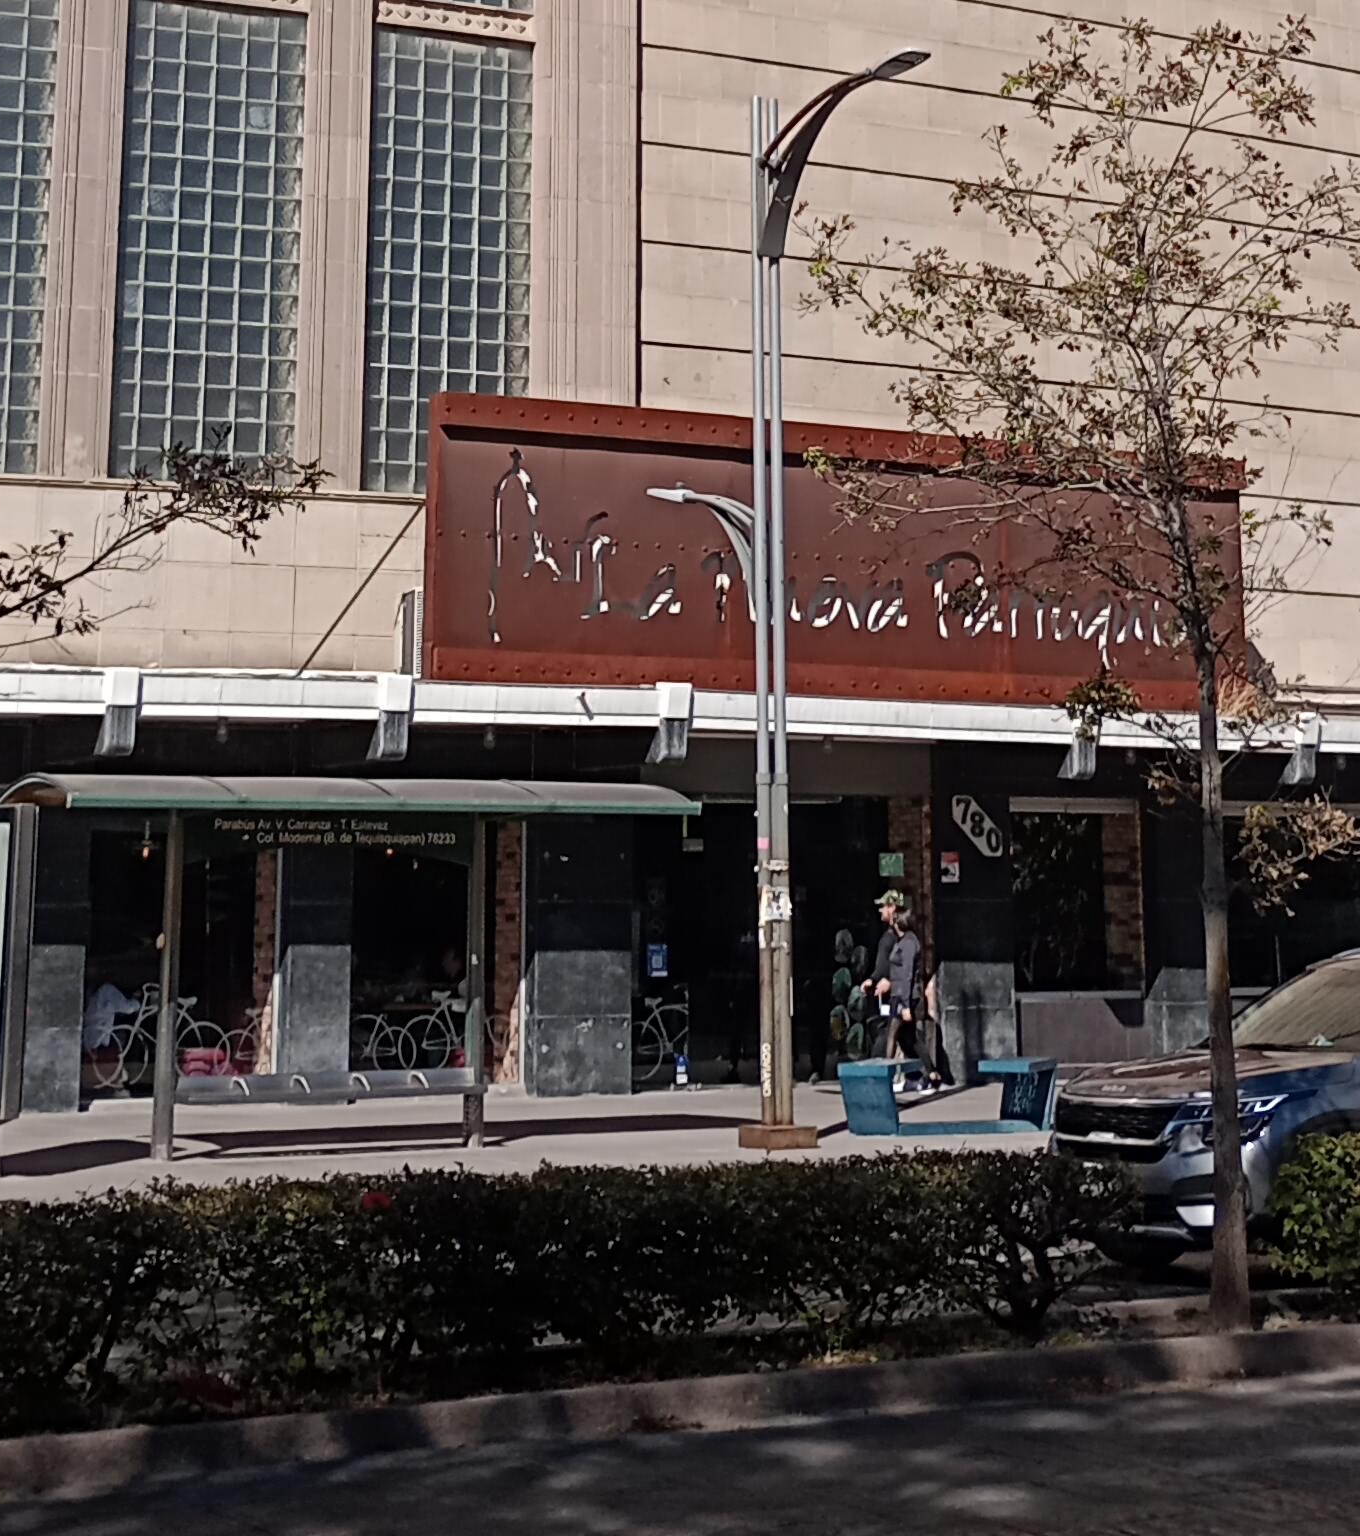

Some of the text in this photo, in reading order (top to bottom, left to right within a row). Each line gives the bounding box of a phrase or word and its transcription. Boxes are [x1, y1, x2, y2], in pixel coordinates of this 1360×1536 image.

[578, 511, 683, 621] La
[287, 818, 332, 830] Carranza
[339, 832, 353, 844] de
[427, 832, 457, 845] 78233
[955, 796, 1001, 854] 780
